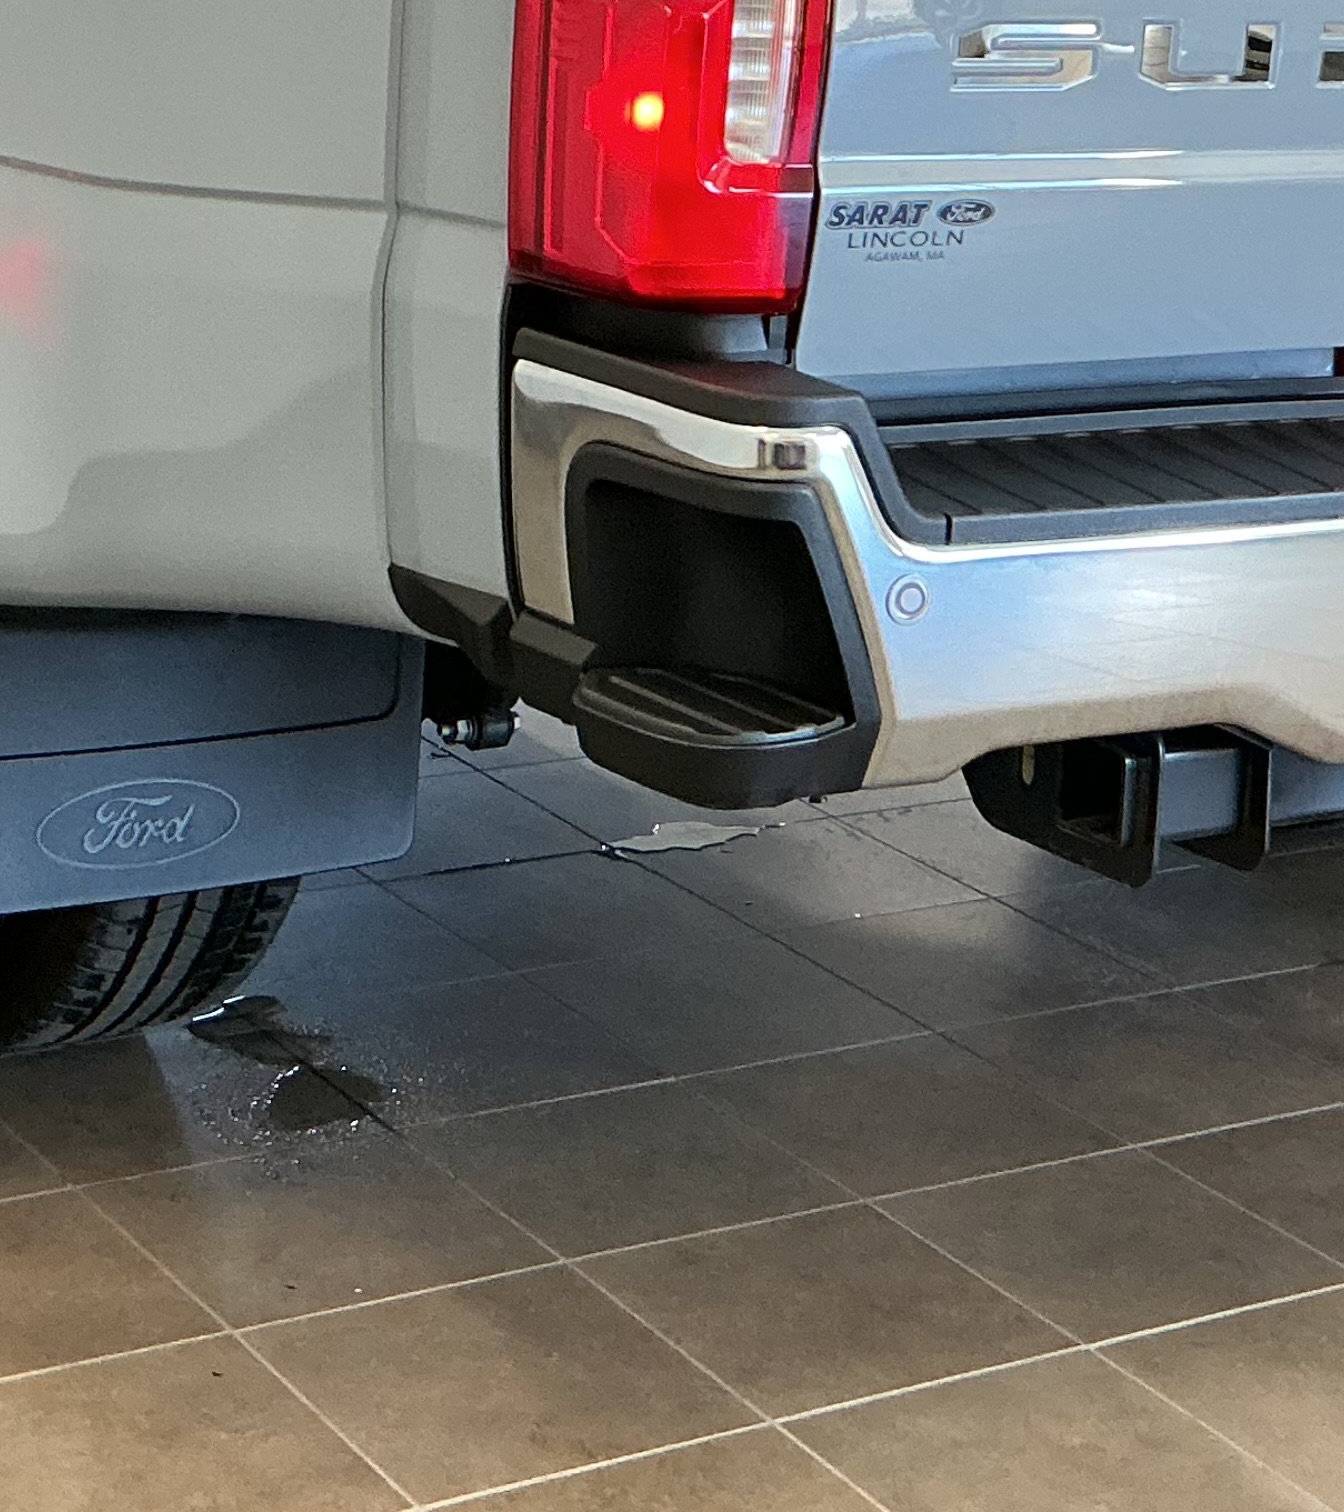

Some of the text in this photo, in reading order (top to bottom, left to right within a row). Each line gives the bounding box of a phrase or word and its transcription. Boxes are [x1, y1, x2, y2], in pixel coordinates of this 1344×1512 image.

[825, 200, 932, 229] SARAT
[847, 230, 965, 248] LINCOLN
[926, 250, 945, 261] MA
[83, 795, 195, 853] Ford
